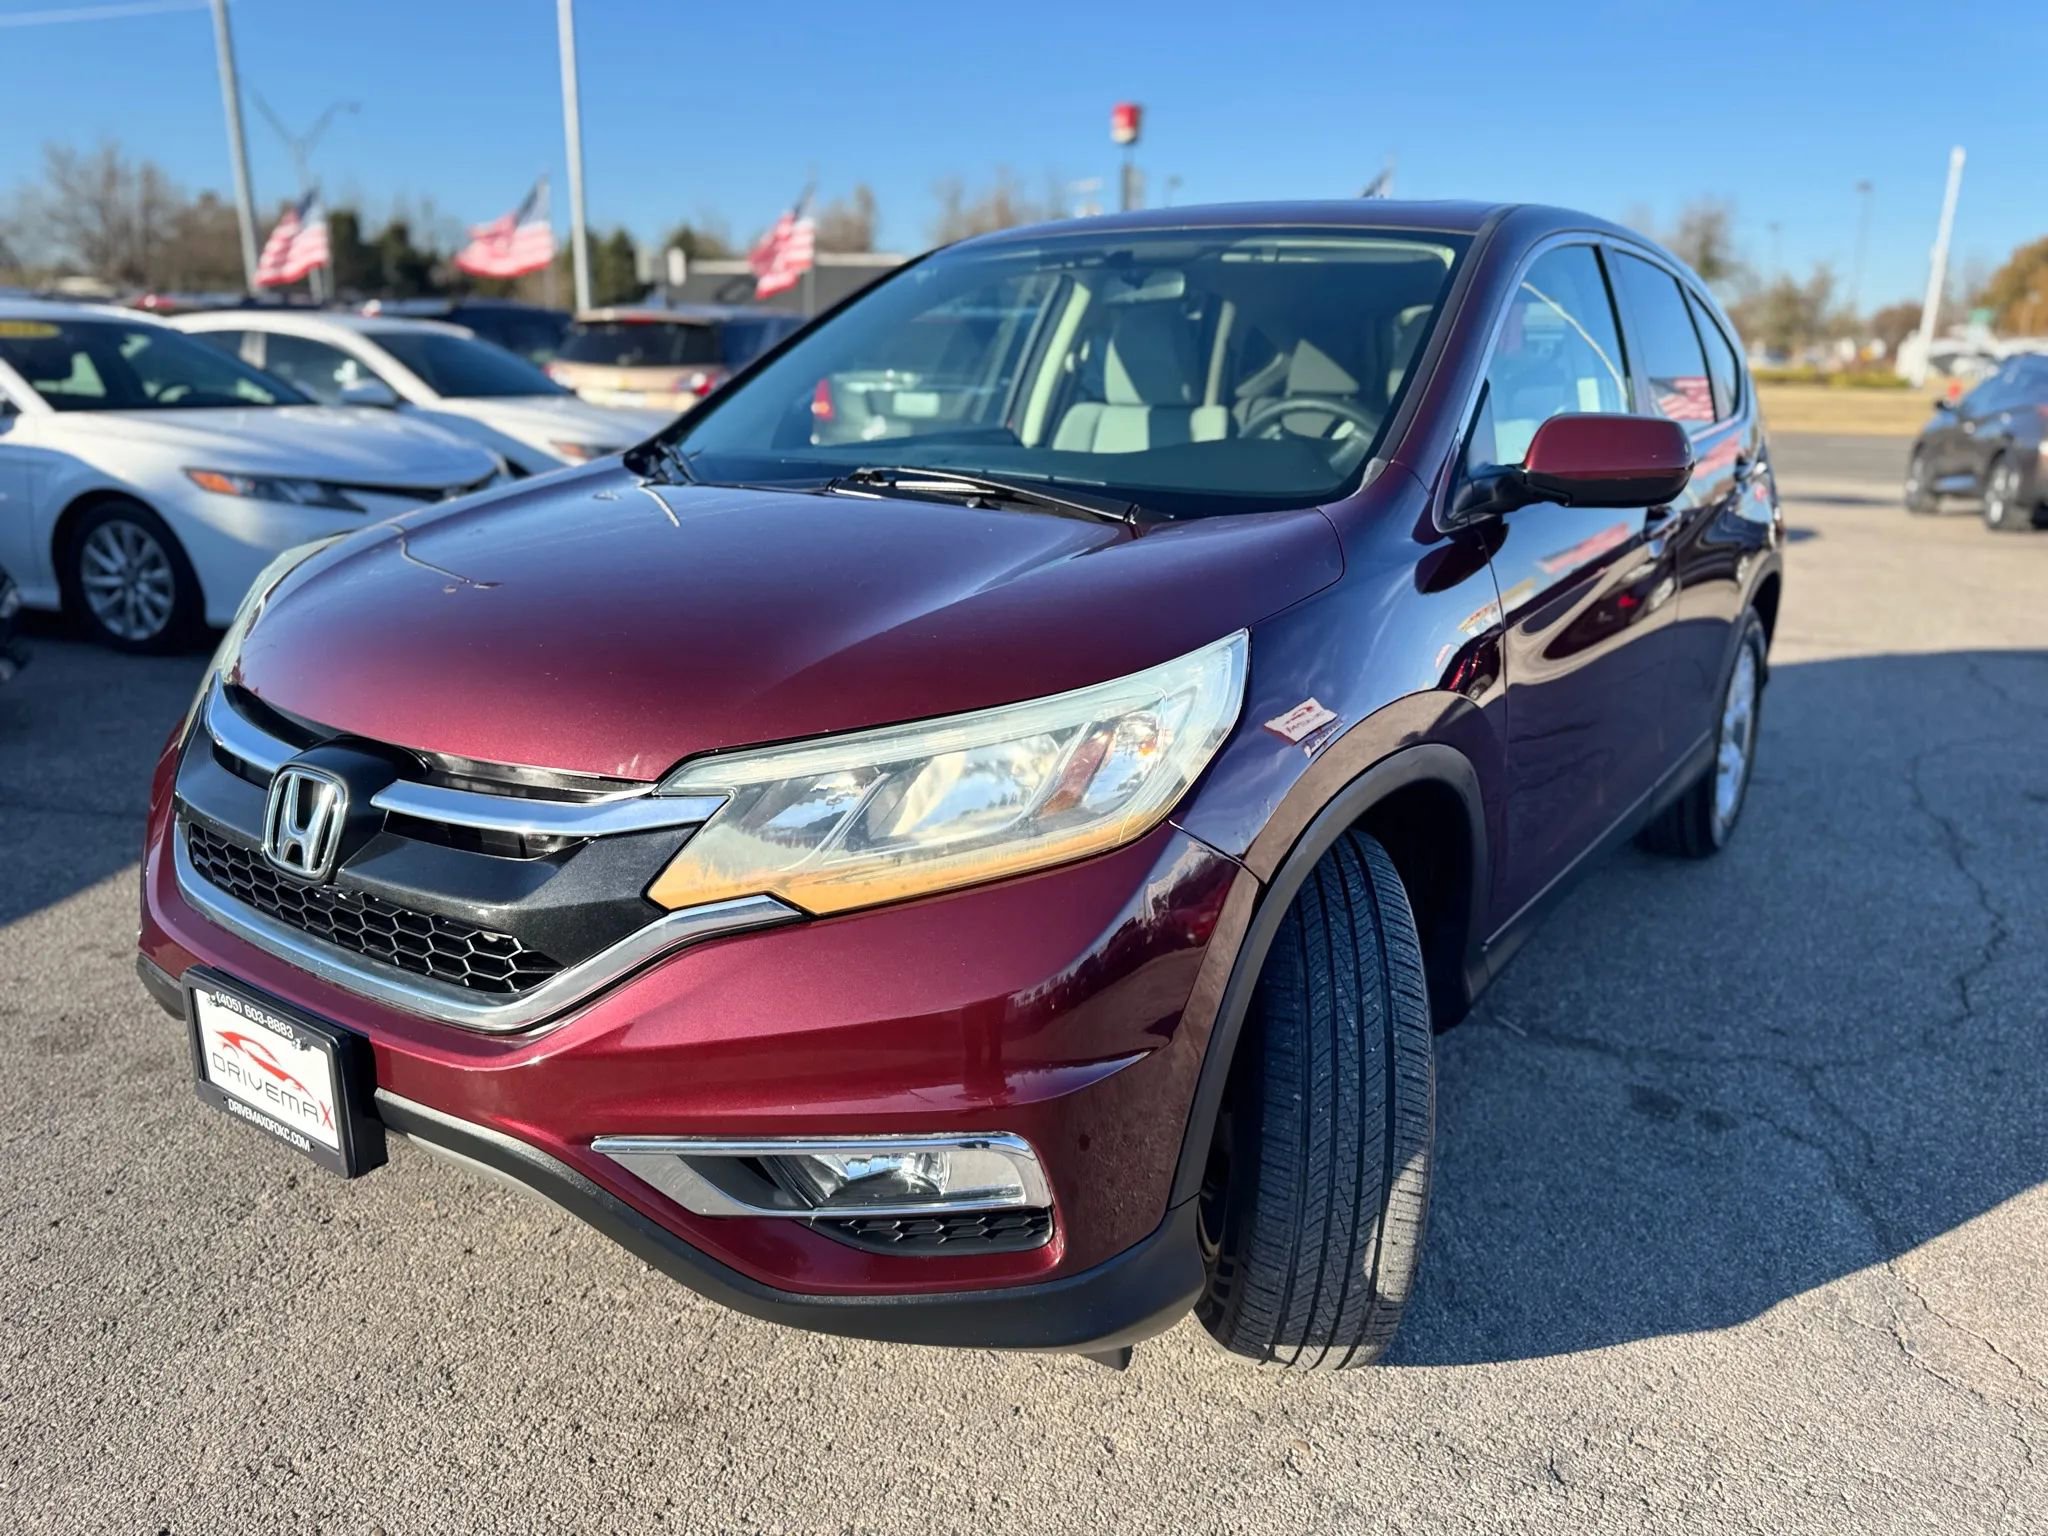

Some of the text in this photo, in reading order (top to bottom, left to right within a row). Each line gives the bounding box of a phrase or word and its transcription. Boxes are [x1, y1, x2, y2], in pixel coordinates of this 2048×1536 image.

[277, 772, 336, 873] H
[216, 991, 294, 1039] (405) 603-8883
[213, 1052, 334, 1131] DRIVEMAX
[228, 1098, 310, 1152] DRIVEMAXOFOKC.COM
